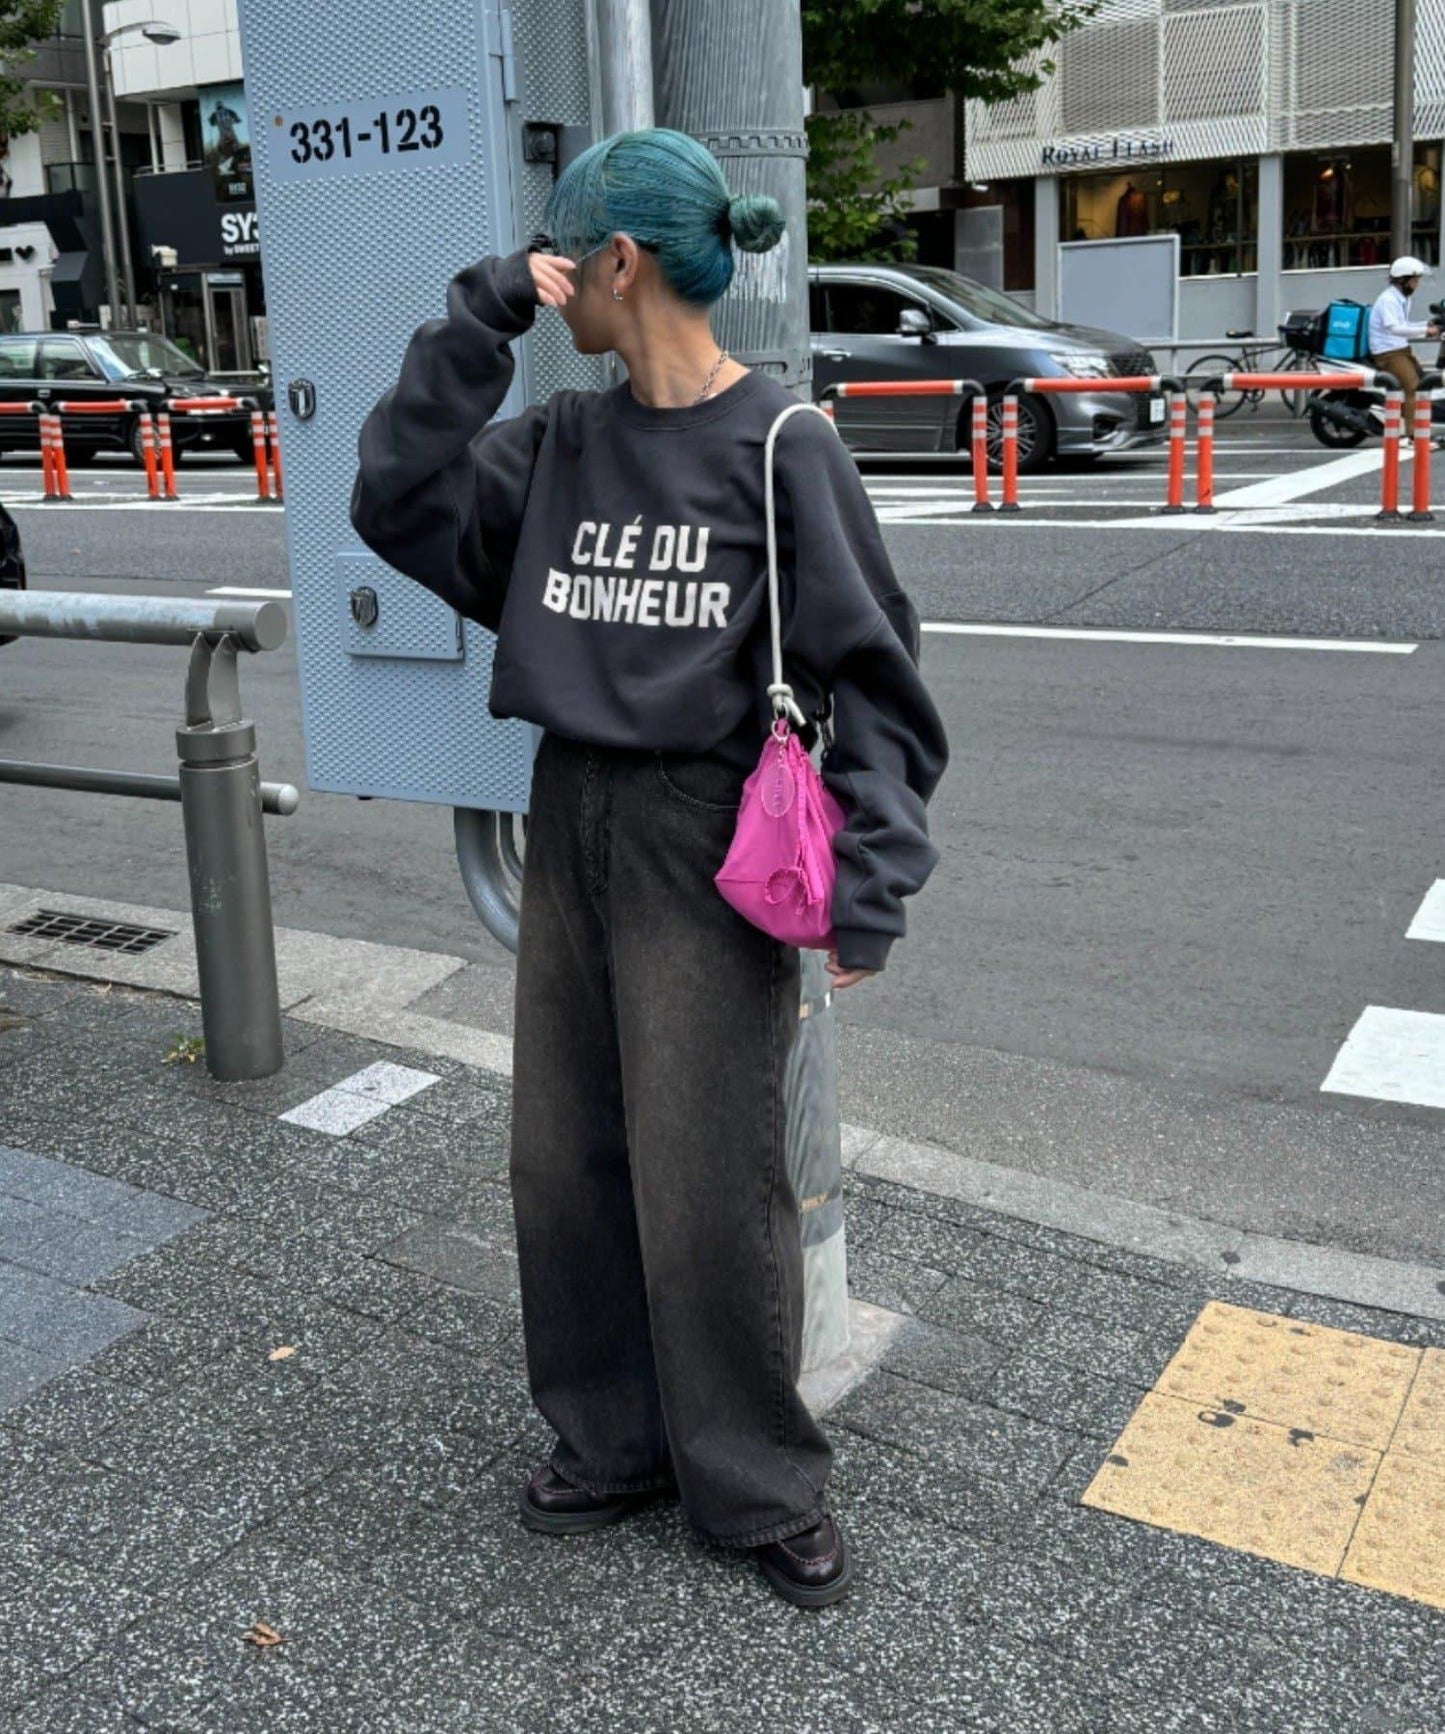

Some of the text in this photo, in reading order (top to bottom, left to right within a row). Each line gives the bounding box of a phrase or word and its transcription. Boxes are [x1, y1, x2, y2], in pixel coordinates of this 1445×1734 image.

[290, 104, 444, 164] 331-123
[571, 514, 710, 572] CLÉ DU
[542, 567, 731, 628] BONHEUR
